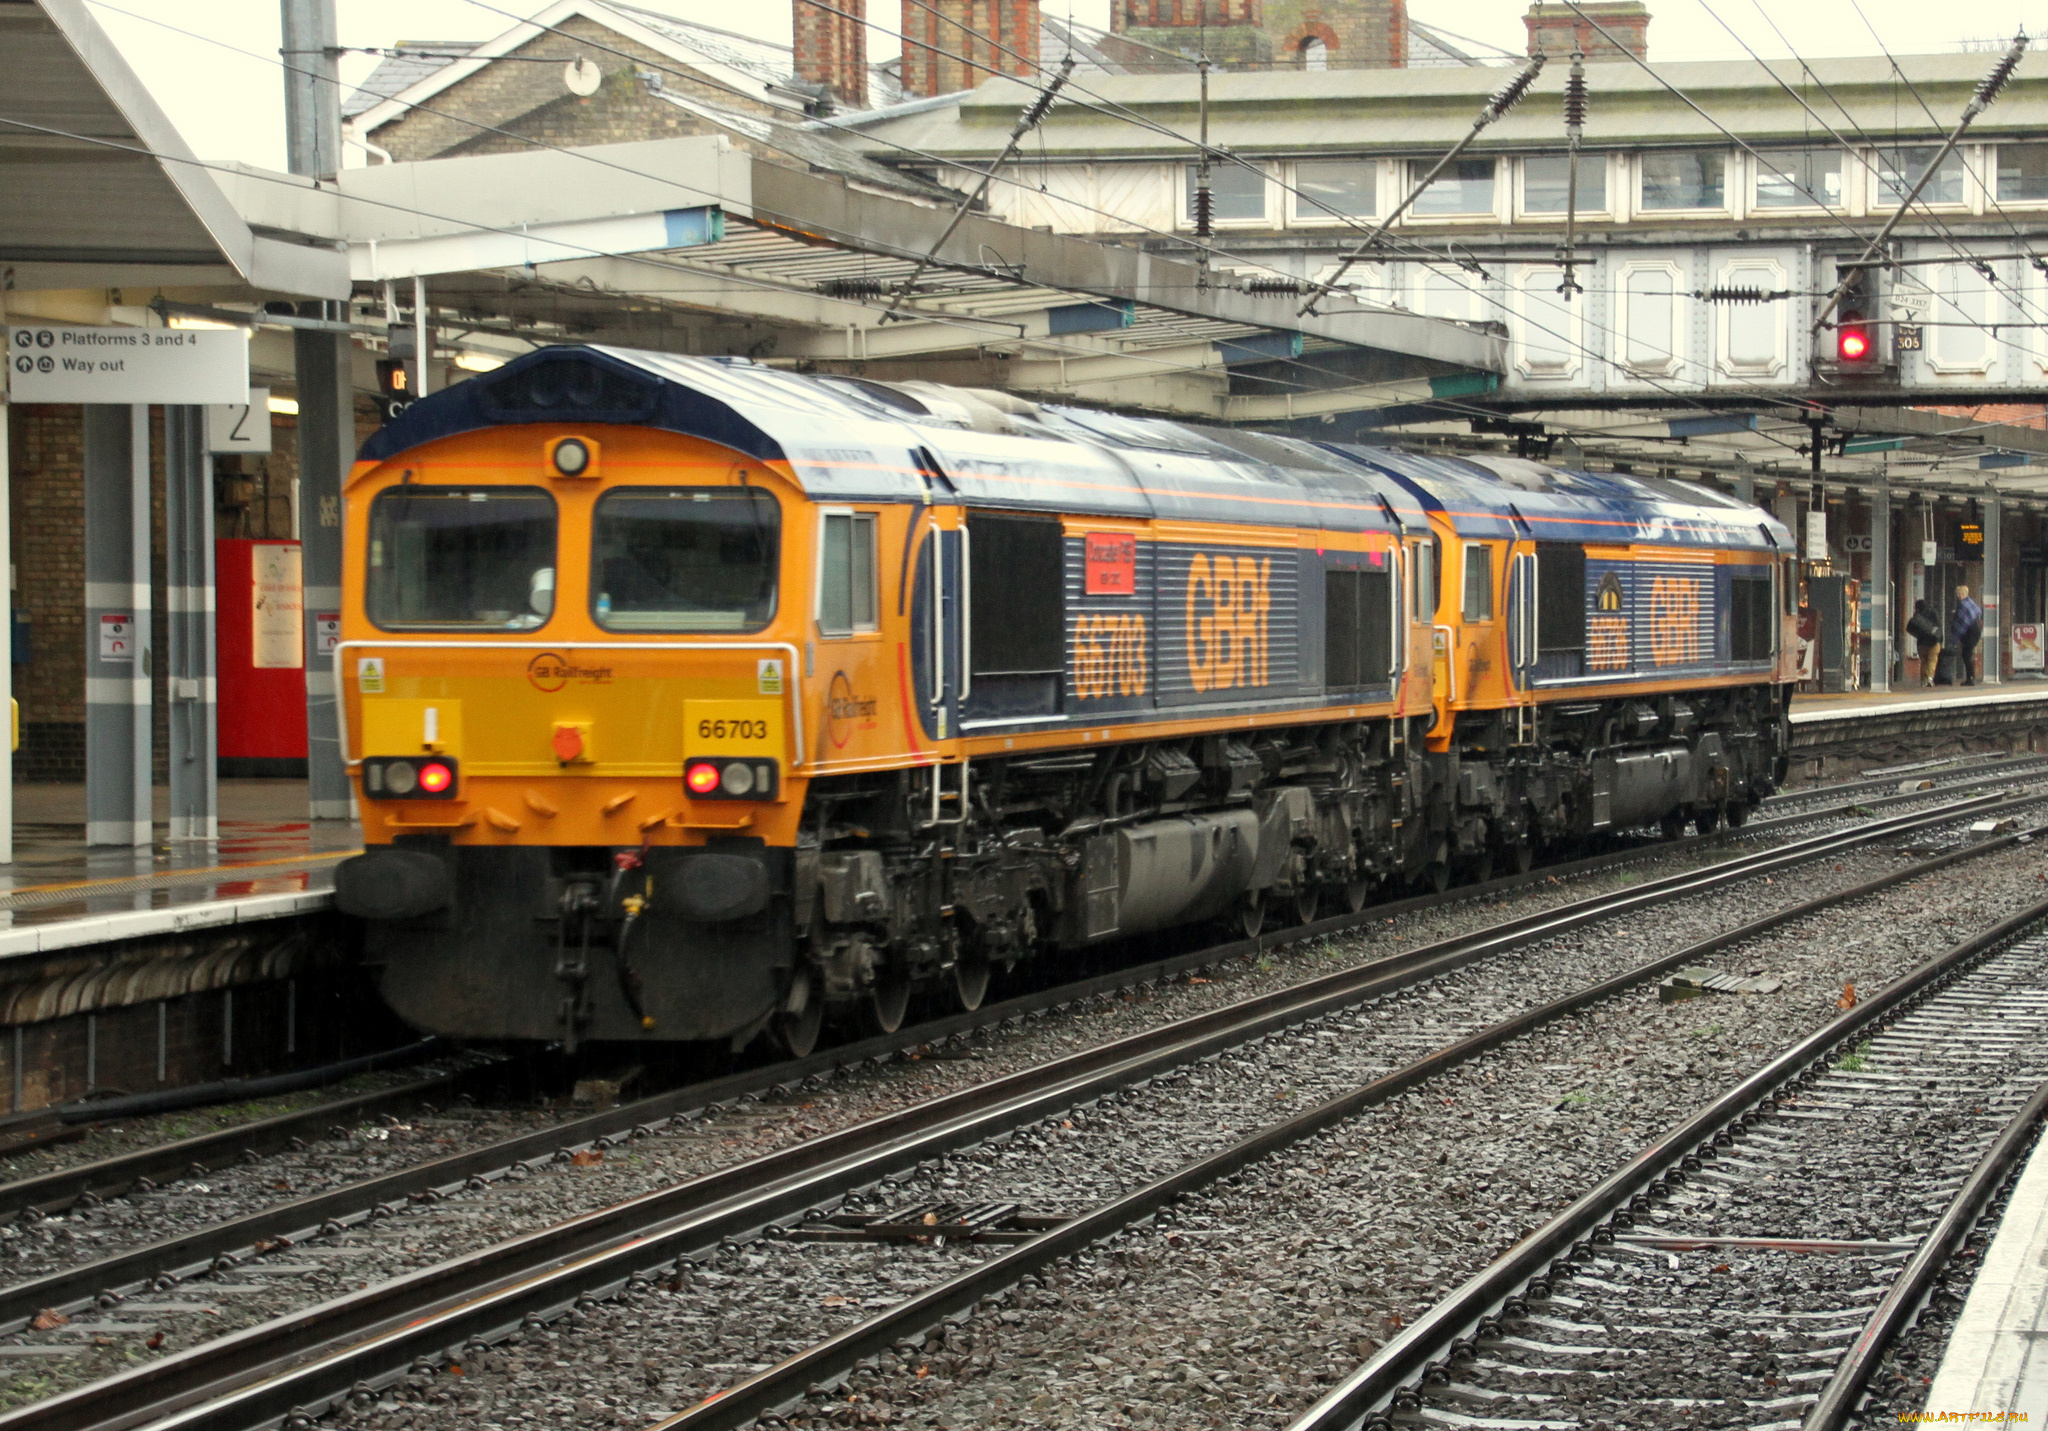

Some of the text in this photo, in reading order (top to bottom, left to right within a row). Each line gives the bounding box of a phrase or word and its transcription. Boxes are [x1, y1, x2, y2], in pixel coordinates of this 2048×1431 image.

[62, 332, 197, 346] Platforms 3 and 4
[1898, 337, 1920, 349] 306
[62, 358, 126, 374] Way out
[229, 404, 250, 441] 2
[1074, 613, 1147, 700] 66703
[534, 666, 550, 678] GB
[698, 719, 767, 739] 66703
